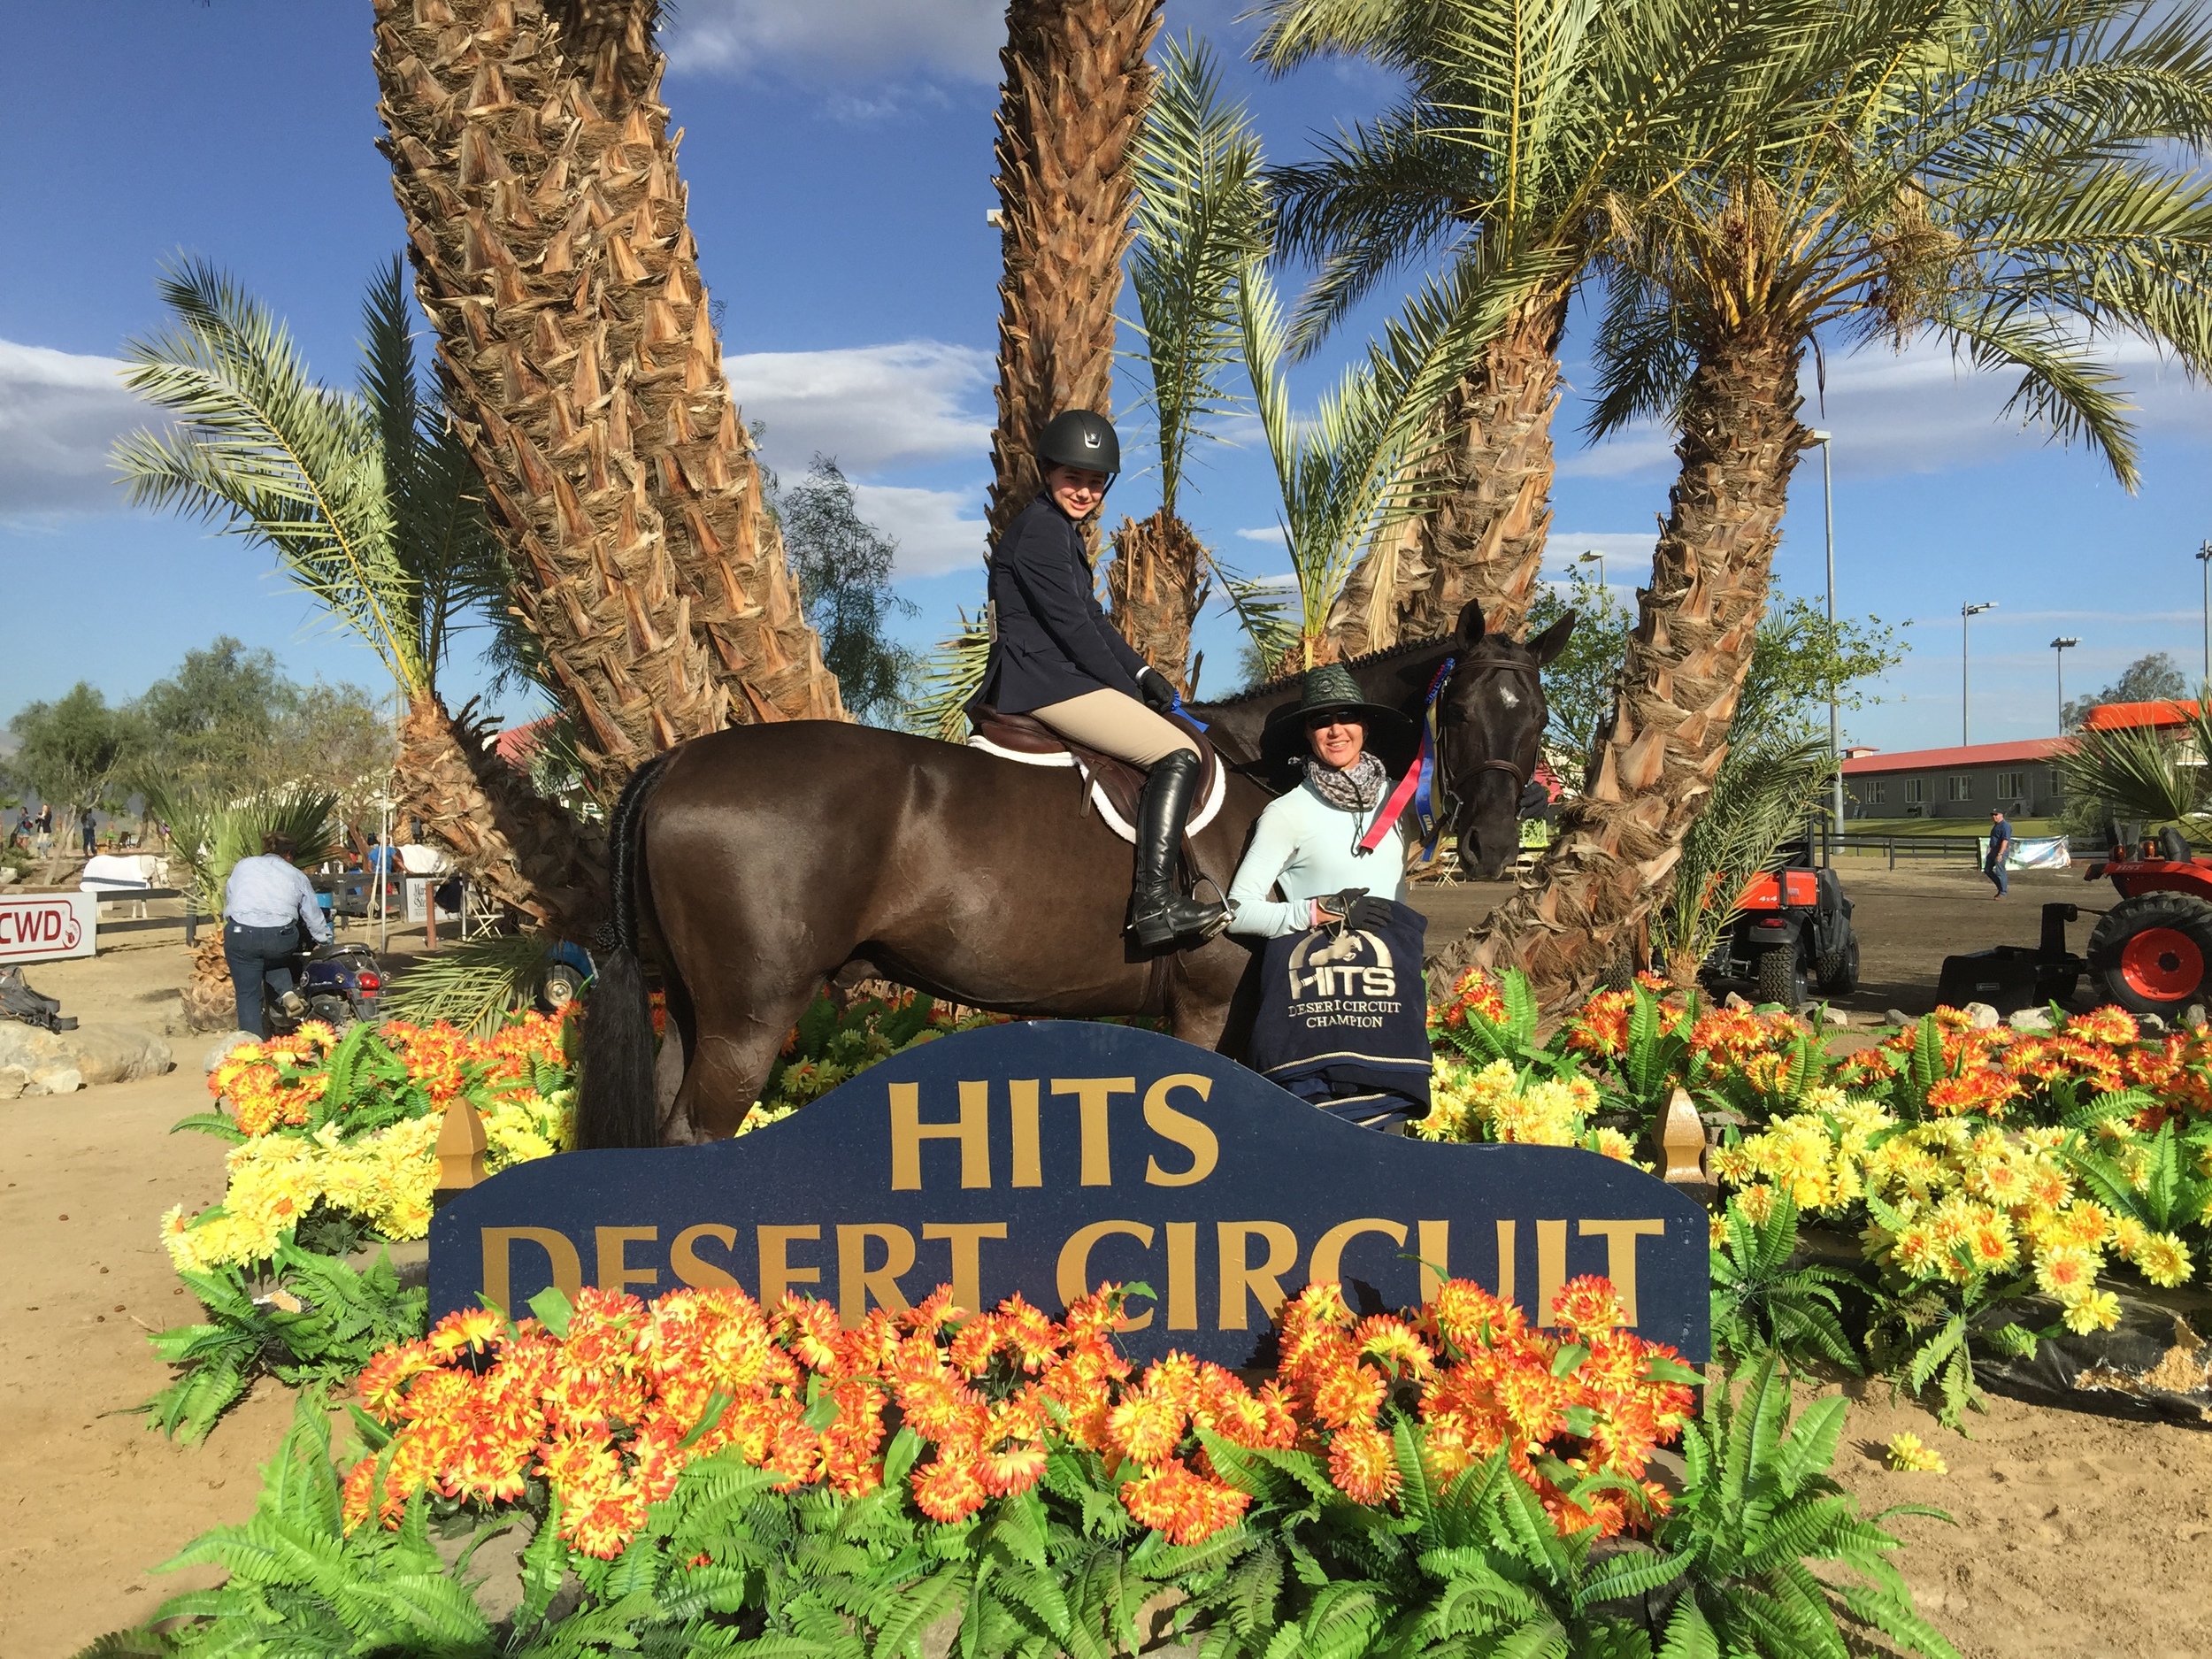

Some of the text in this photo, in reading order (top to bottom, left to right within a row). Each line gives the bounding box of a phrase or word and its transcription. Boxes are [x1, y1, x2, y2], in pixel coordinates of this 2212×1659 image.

[0, 910, 62, 944] CWD
[1288, 965, 1396, 1000] HITS
[1287, 1000, 1402, 1018] DESERT CIRCUIT
[1306, 1014, 1383, 1028] CHAMPION
[887, 1073, 1219, 1191] HITS
[1056, 1218, 1665, 1333] CIRCUIT
